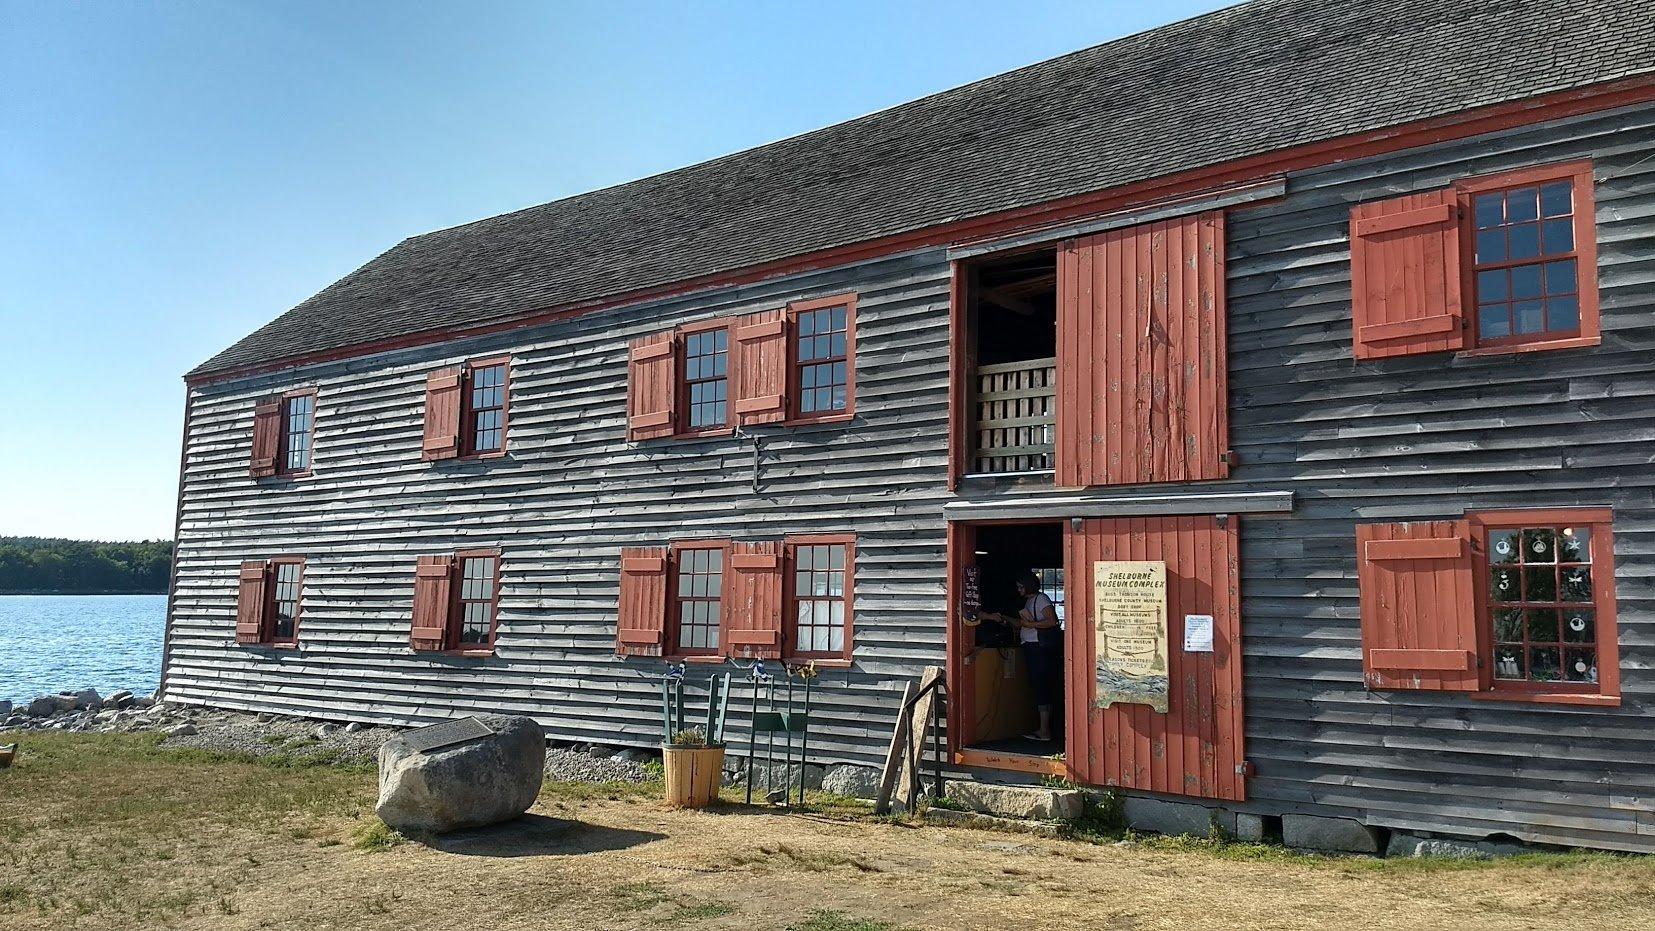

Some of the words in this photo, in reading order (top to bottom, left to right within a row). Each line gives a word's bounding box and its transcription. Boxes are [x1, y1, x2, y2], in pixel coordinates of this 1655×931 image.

[1108, 572, 1152, 580] SHELBURNE
[1096, 580, 1128, 588] MUSEUM
[1128, 580, 1165, 588] COMPLEX
